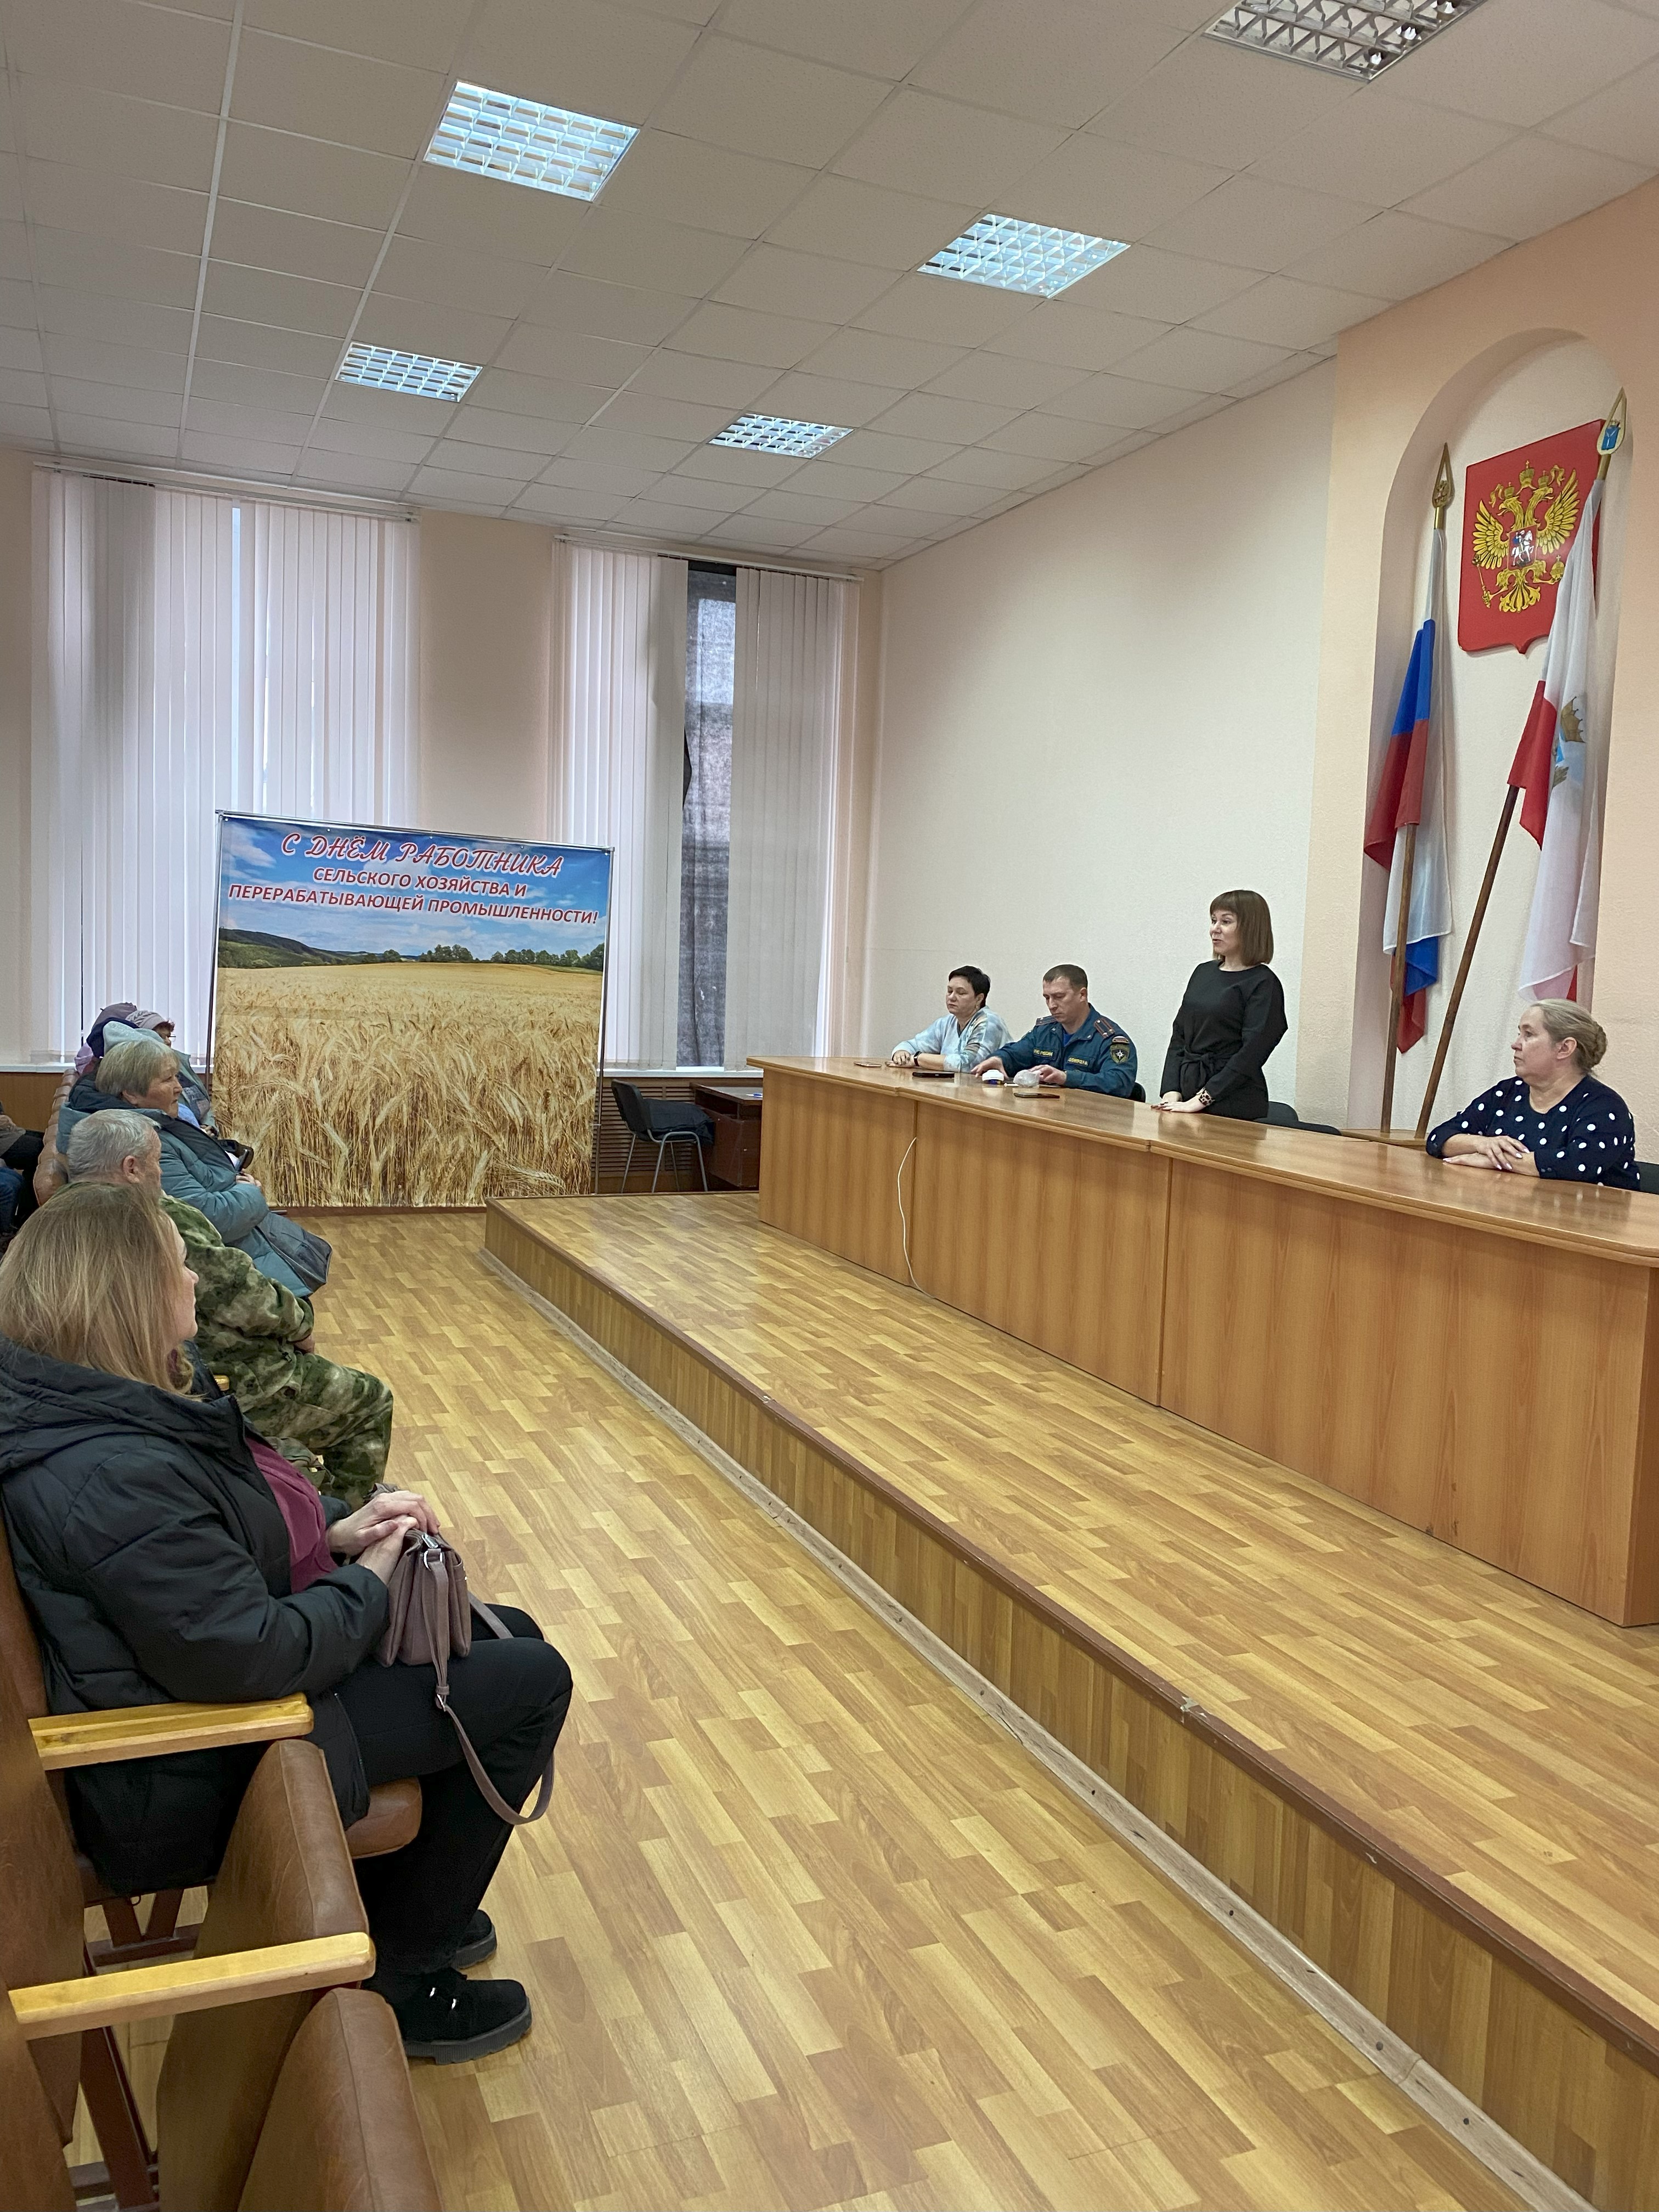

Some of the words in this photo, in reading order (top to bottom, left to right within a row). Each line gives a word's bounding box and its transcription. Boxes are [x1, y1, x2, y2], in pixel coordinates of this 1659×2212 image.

[282, 833, 301, 854] С
[306, 835, 390, 861] ДНЁМ
[395, 842, 563, 876] РАБОТНИКА
[314, 868, 411, 888] СЕЛЬСКОГО
[415, 875, 510, 896] ХОЗЯЙСТВА
[514, 884, 527, 897] И
[229, 884, 424, 912] ПЕРЕРАБАТЫВАЮЩЕЙ
[427, 899, 599, 924] ПРОМЫШЛЕННОСТИ!
